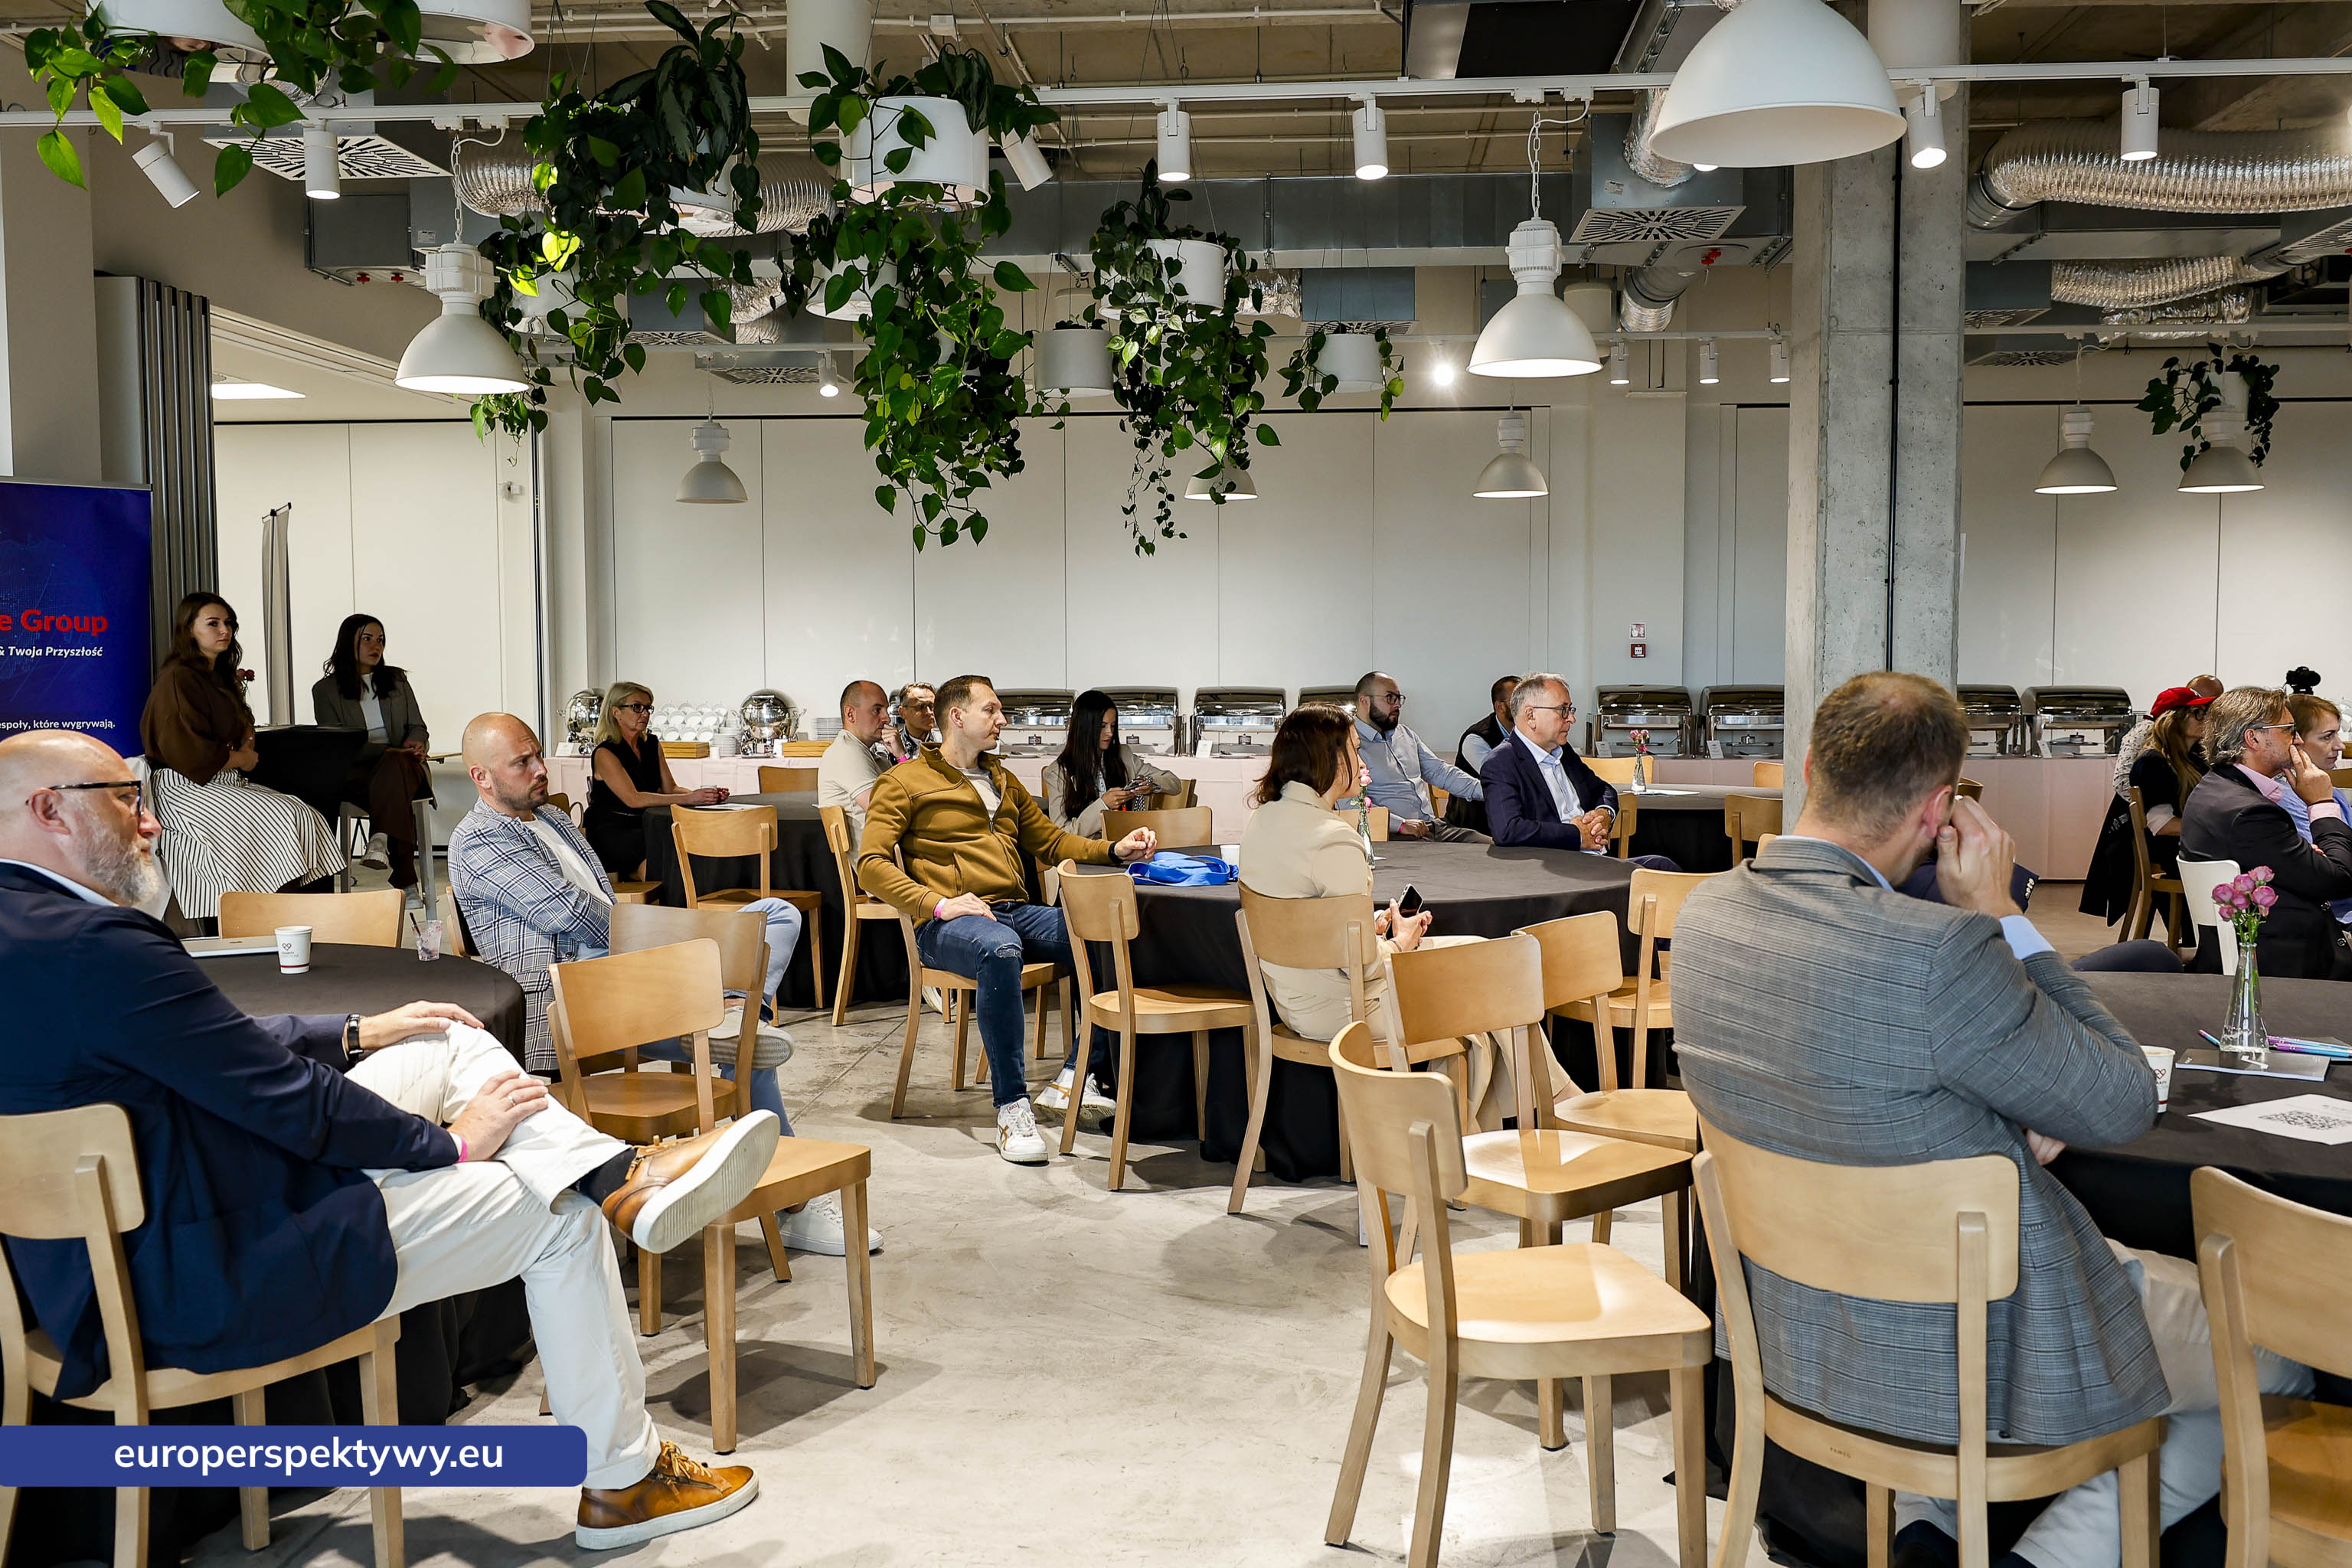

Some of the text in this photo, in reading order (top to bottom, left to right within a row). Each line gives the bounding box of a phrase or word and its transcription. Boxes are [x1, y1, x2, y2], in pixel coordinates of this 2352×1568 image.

[21, 609, 108, 636] Group
[8, 645, 43, 658] Twoja
[45, 645, 103, 658] Przyszłość
[0, 718, 116, 730] społy, które wygrywają.
